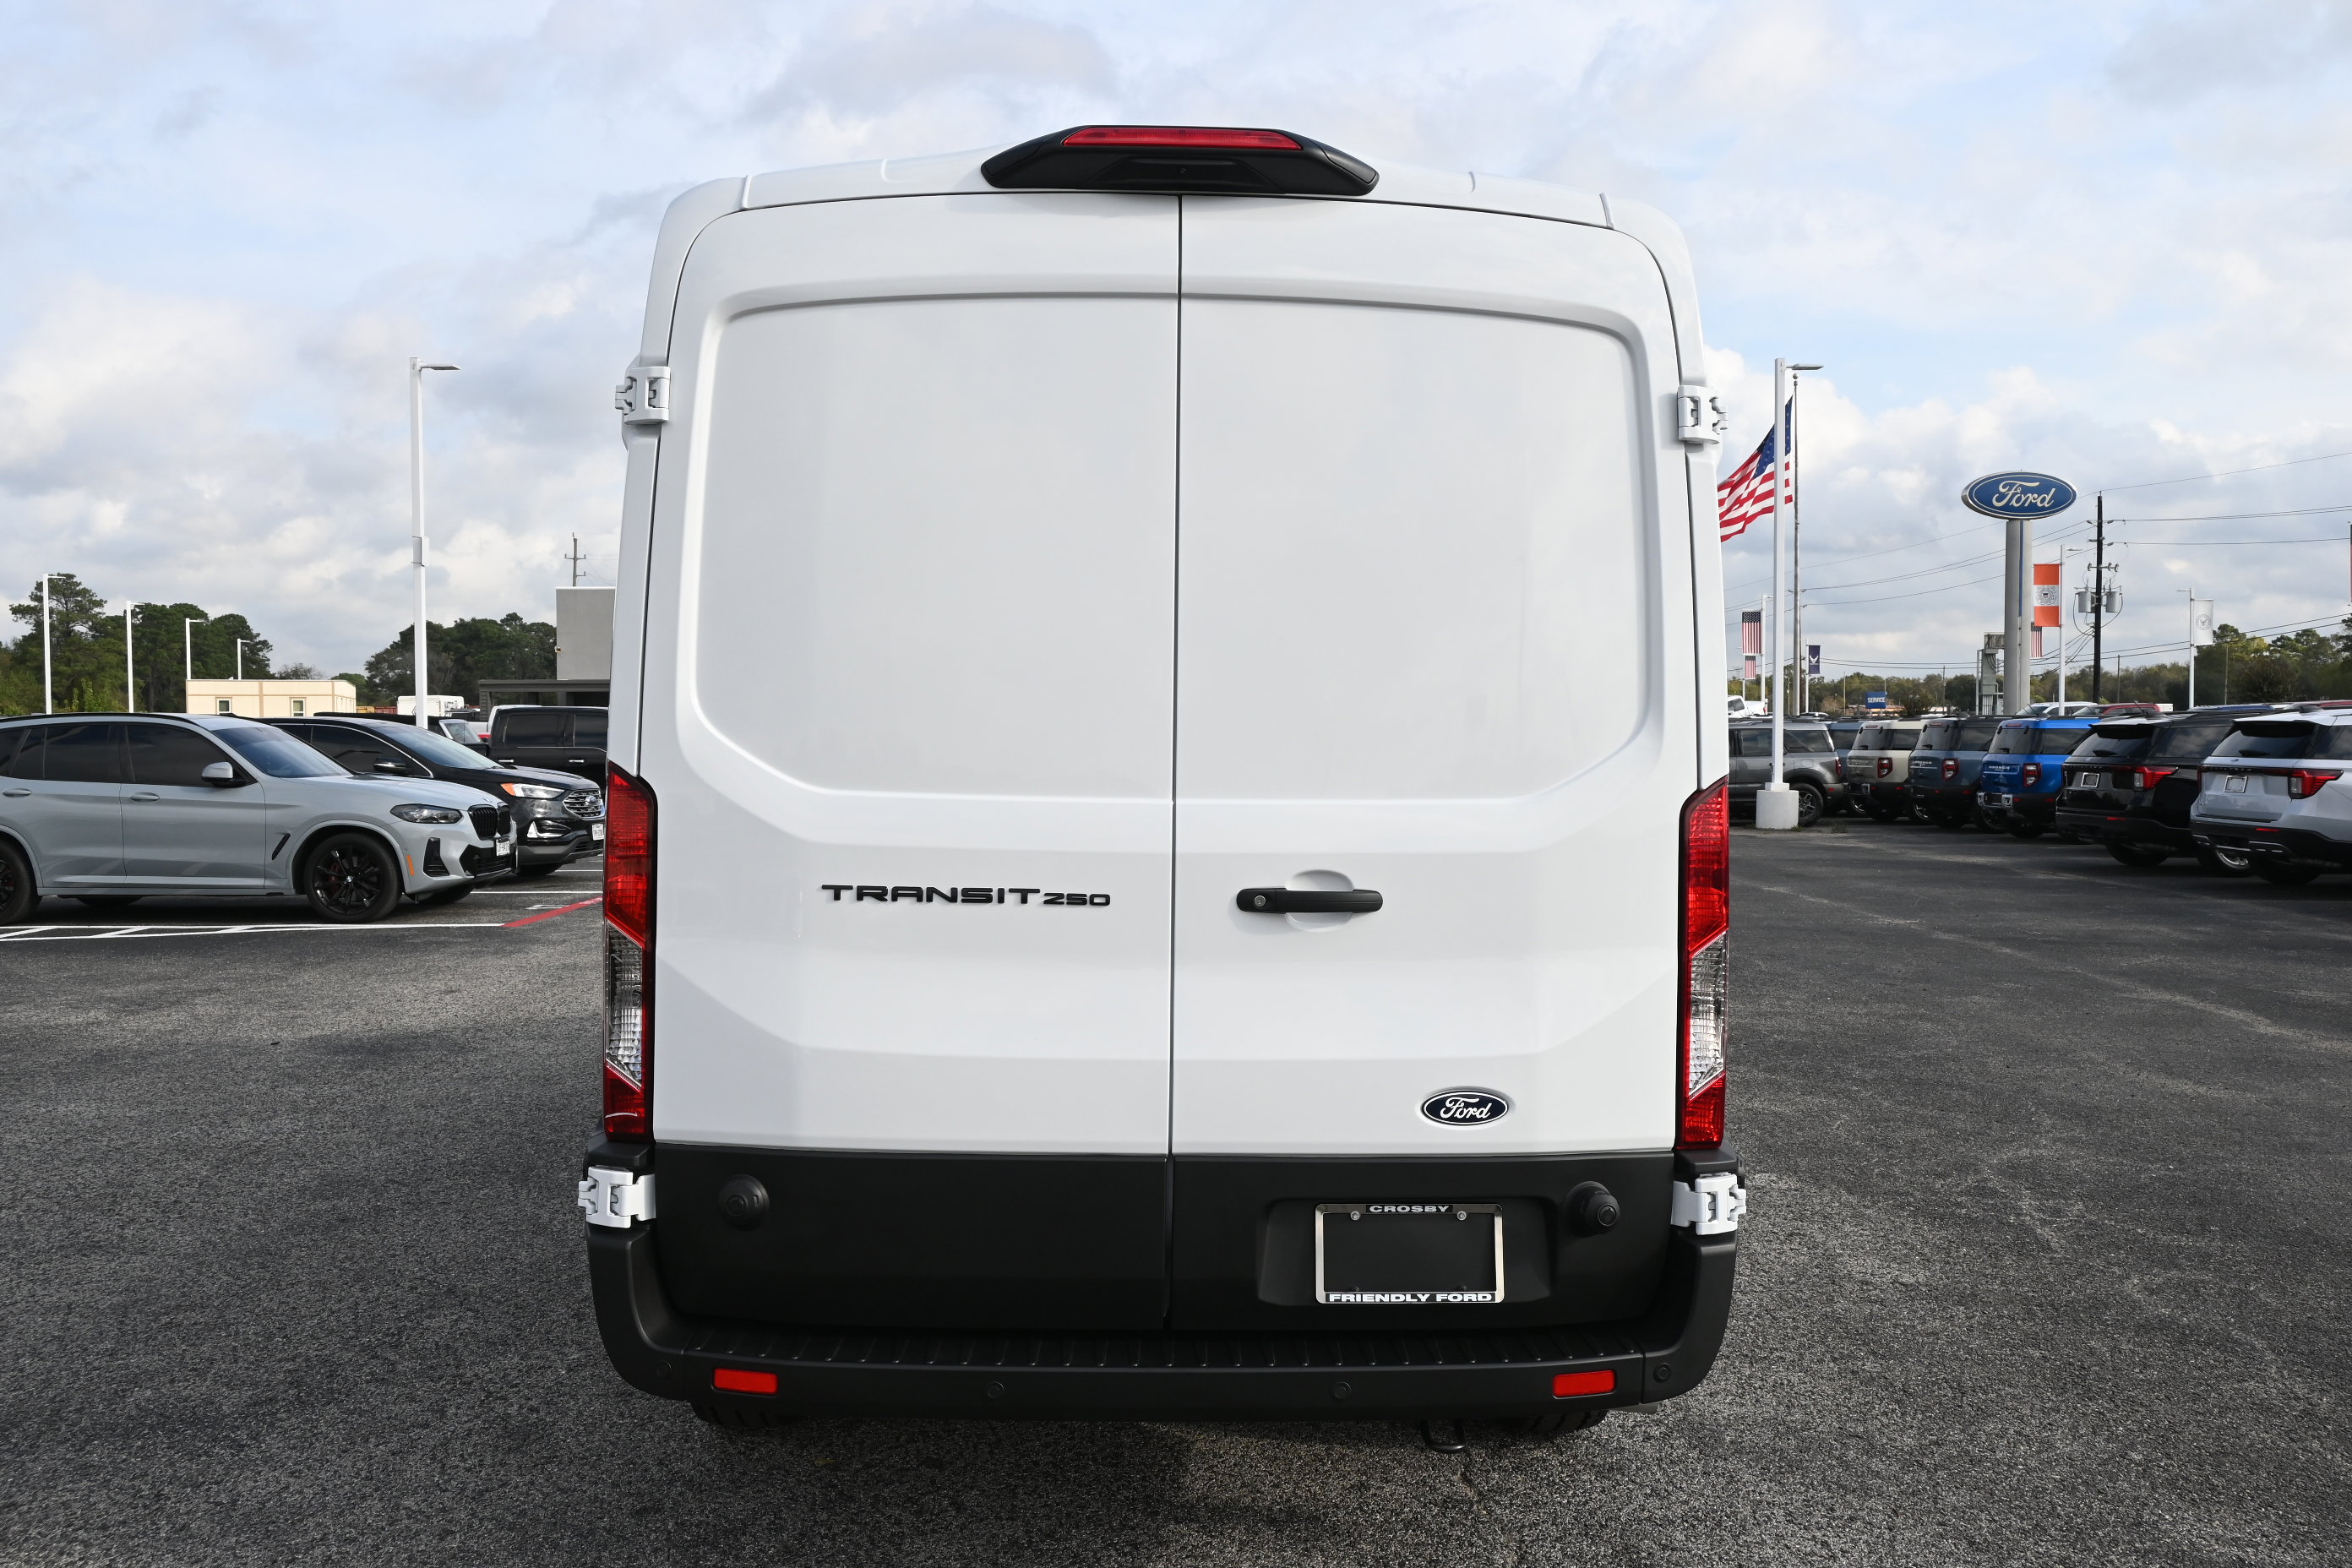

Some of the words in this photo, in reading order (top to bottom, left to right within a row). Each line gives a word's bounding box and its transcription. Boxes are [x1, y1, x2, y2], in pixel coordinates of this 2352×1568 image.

[1991, 480, 2056, 508] Ford
[821, 885, 1041, 904] TRANSIT
[1043, 892, 1111, 906] 250
[1440, 1097, 1493, 1119] Ford
[1369, 1205, 1450, 1213] CROSBY
[1329, 1293, 1431, 1303] FRIENDLY
[1435, 1293, 1493, 1302] FORD
